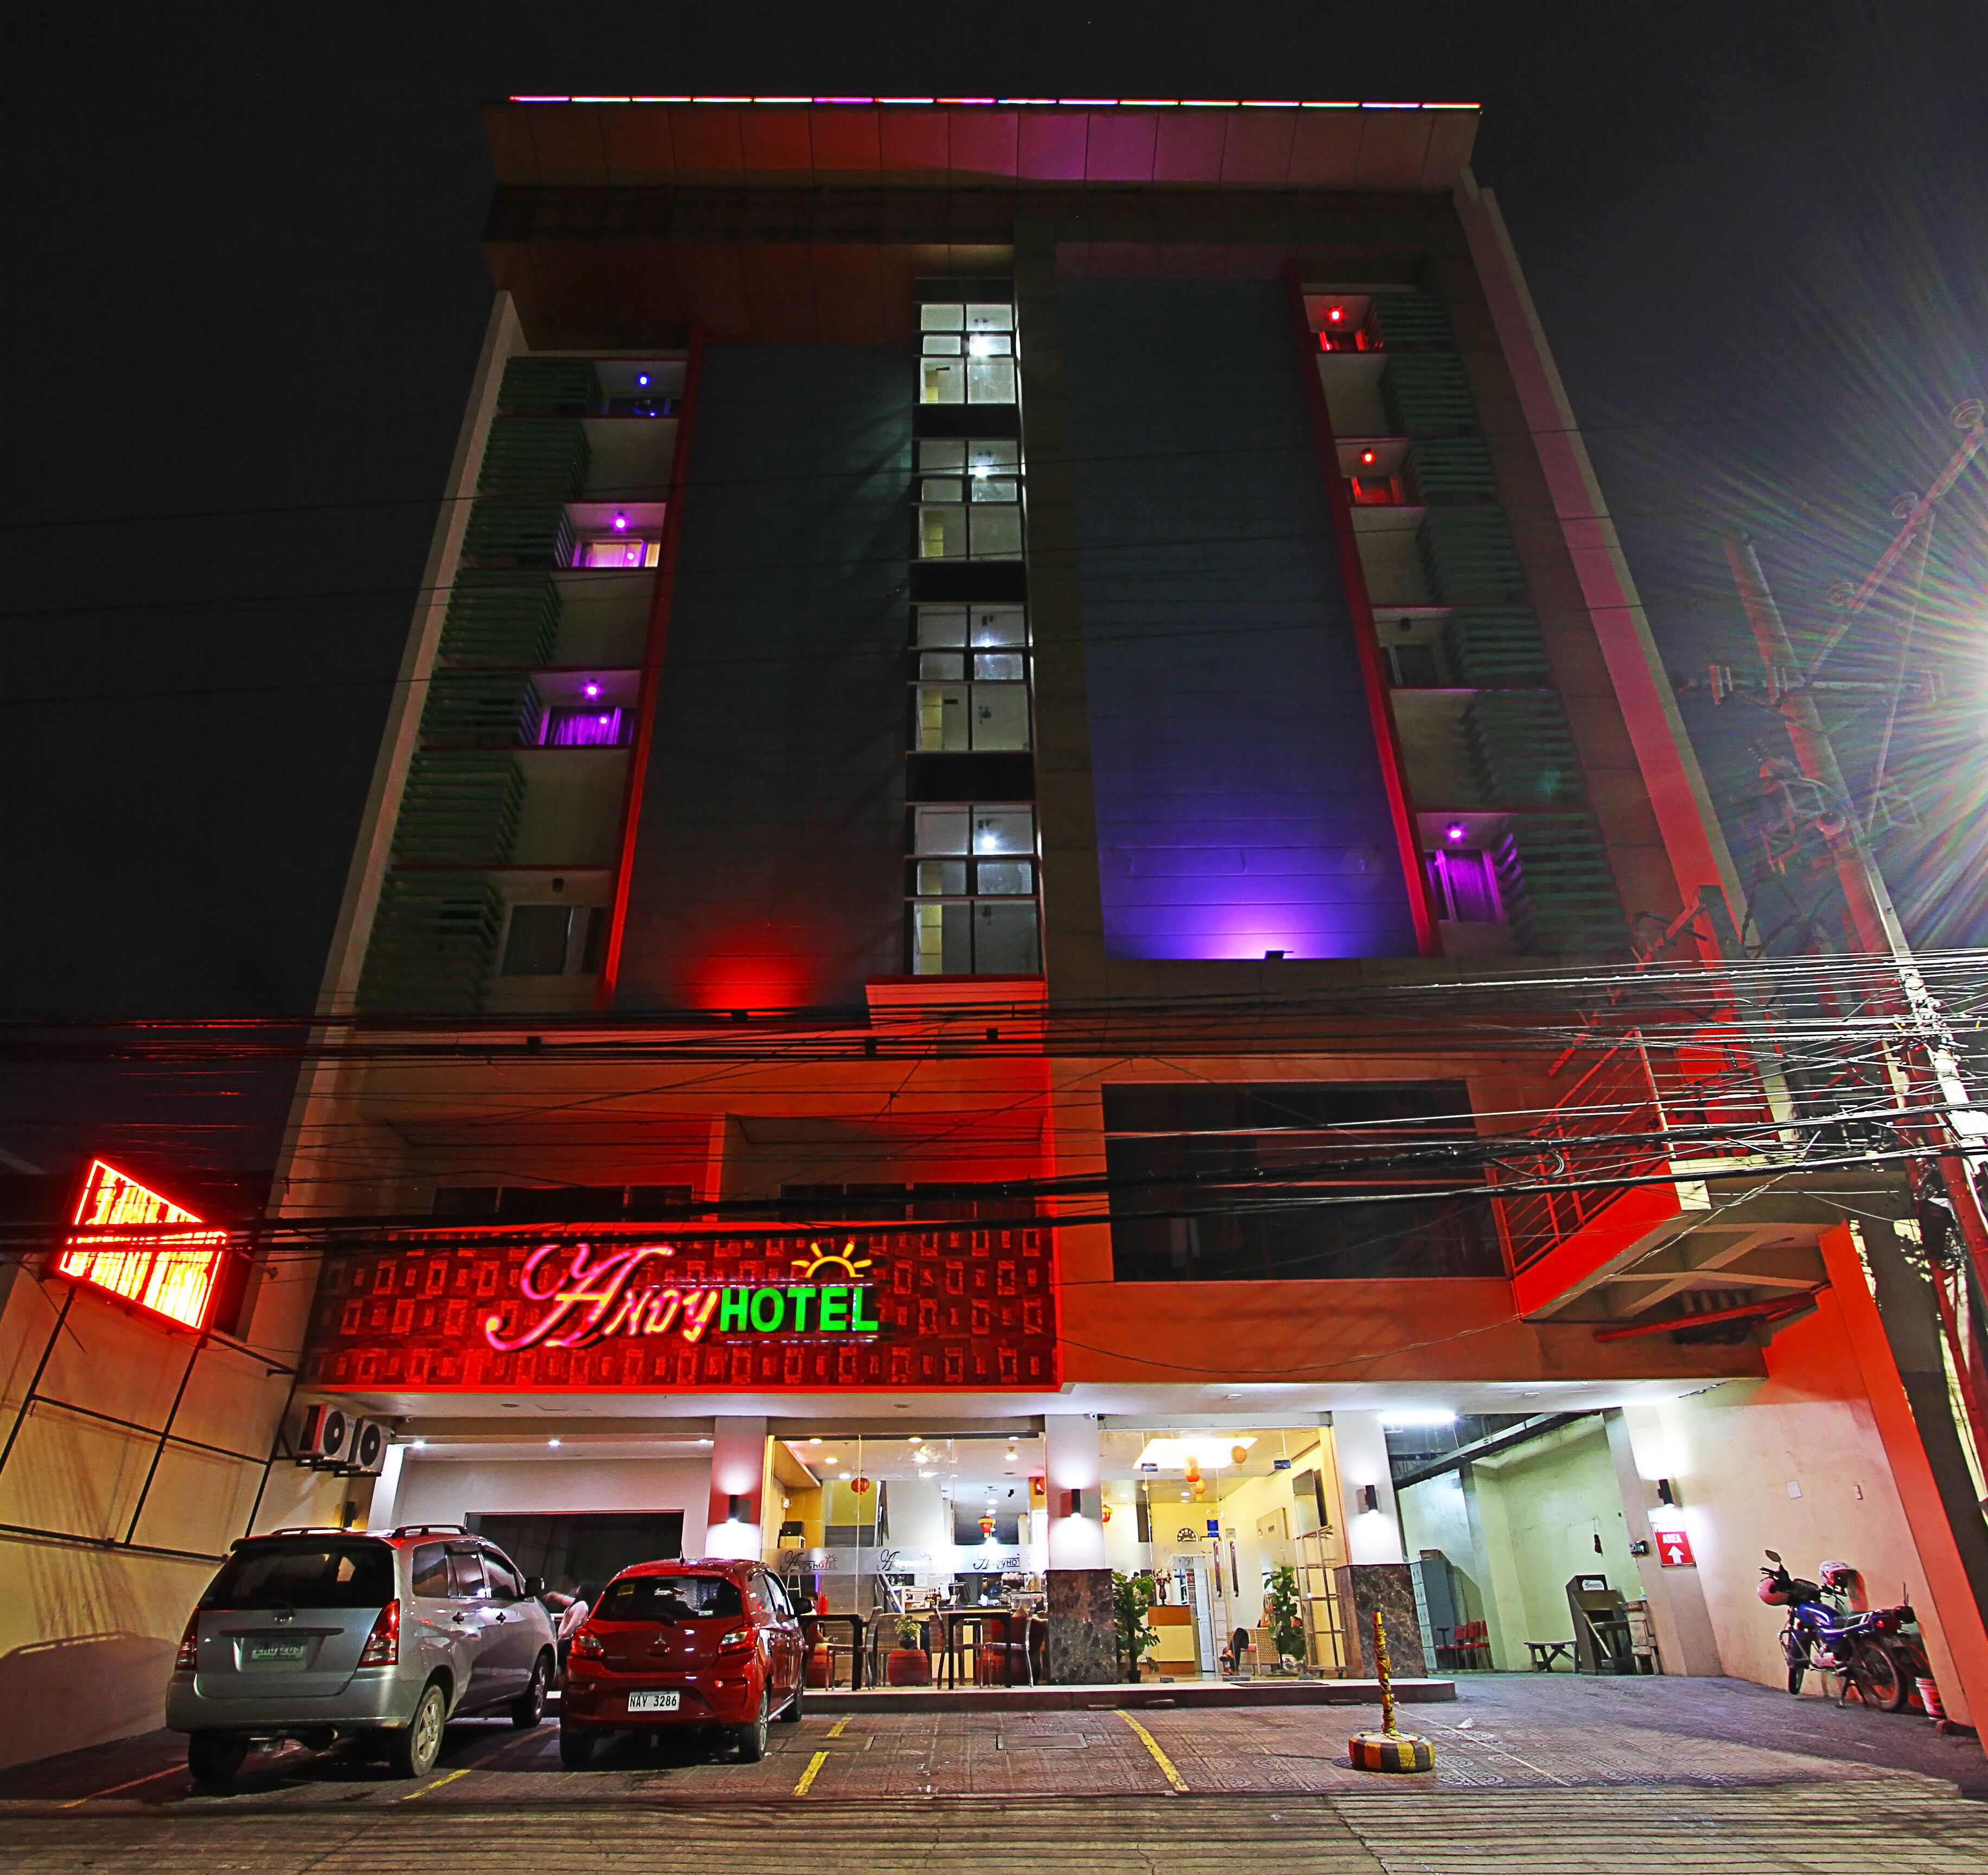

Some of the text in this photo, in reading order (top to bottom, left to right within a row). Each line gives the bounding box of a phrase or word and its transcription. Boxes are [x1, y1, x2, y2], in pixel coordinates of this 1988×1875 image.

[719, 1287, 878, 1332] HOTEL
[1662, 1533, 1683, 1544] AREA
[630, 1695, 677, 1707] NAY 3286
